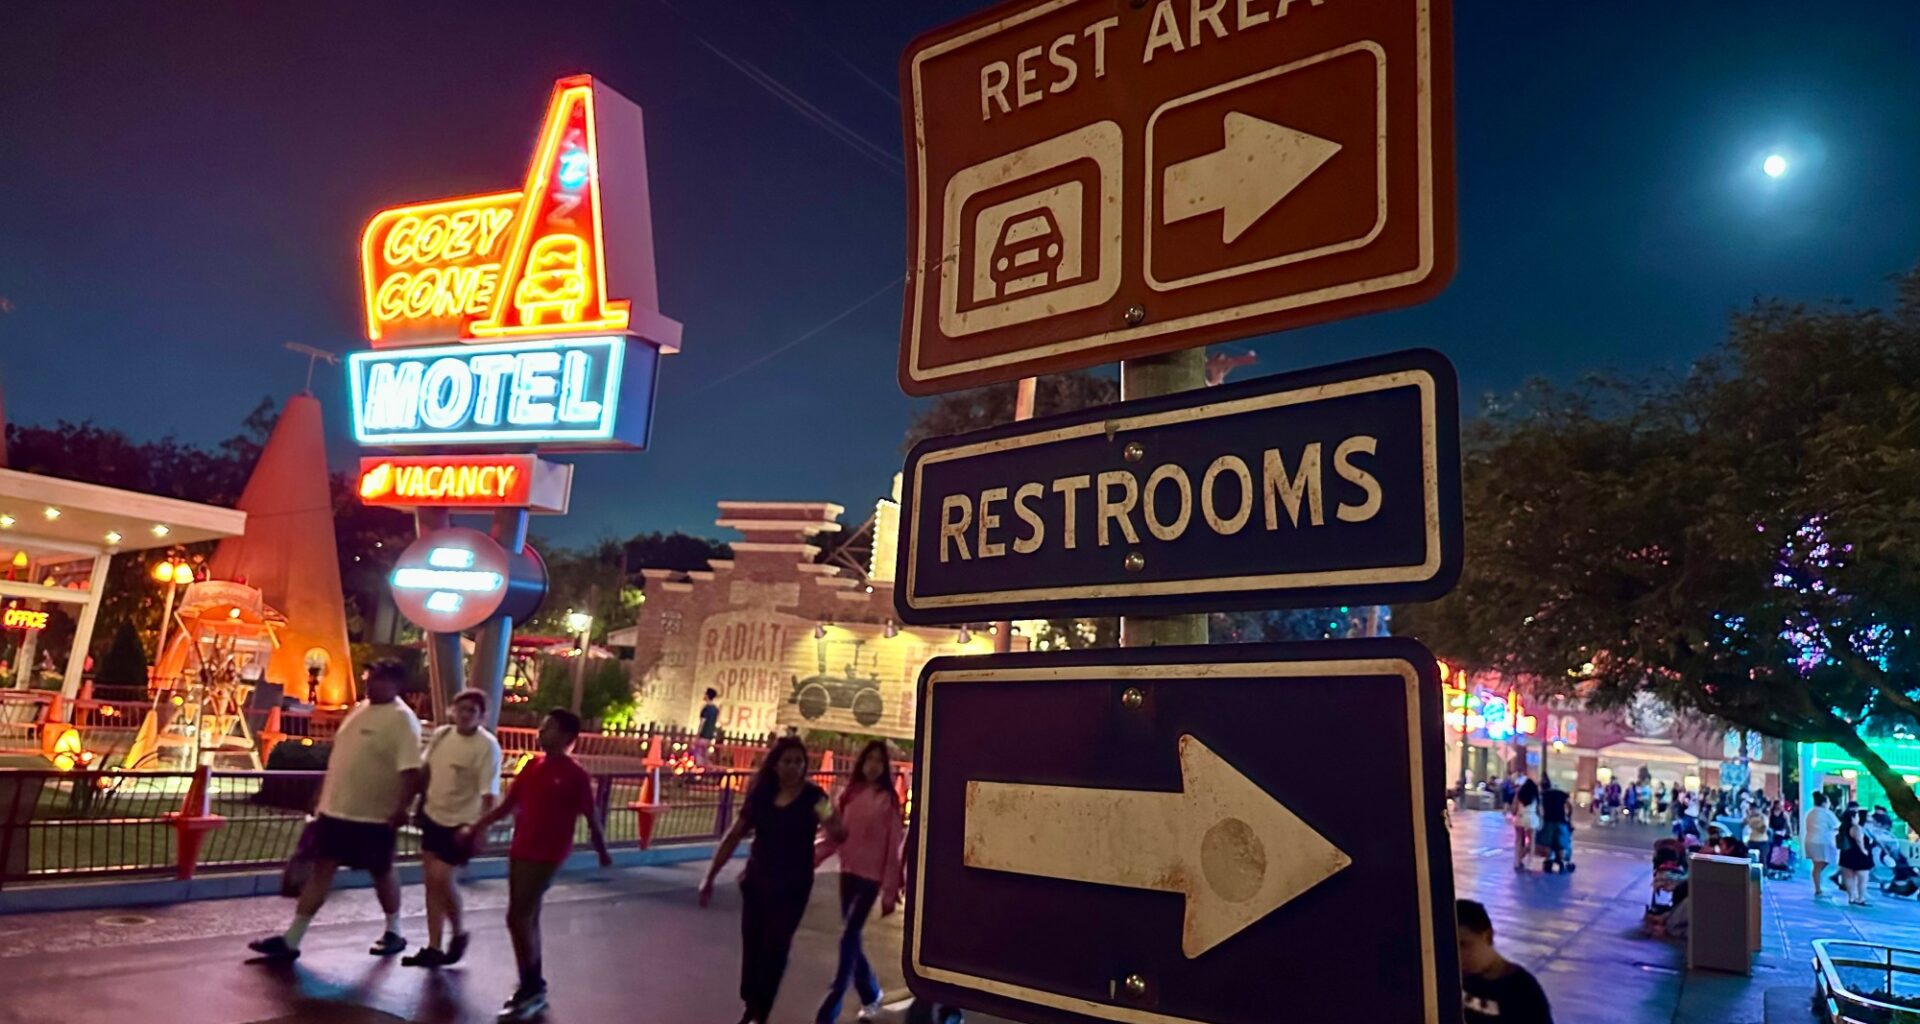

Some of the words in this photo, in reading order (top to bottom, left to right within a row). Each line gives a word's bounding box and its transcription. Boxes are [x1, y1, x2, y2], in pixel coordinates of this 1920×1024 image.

[980, 16, 1119, 121] REST
[383, 208, 513, 266] COZY
[375, 263, 501, 321] CONE
[363, 349, 602, 429] MOTEL
[394, 465, 514, 497] VACANCY
[939, 435, 1384, 563] RESTROOMS
[4, 608, 49, 629] OFFICE
[703, 620, 788, 666] RADIAT
